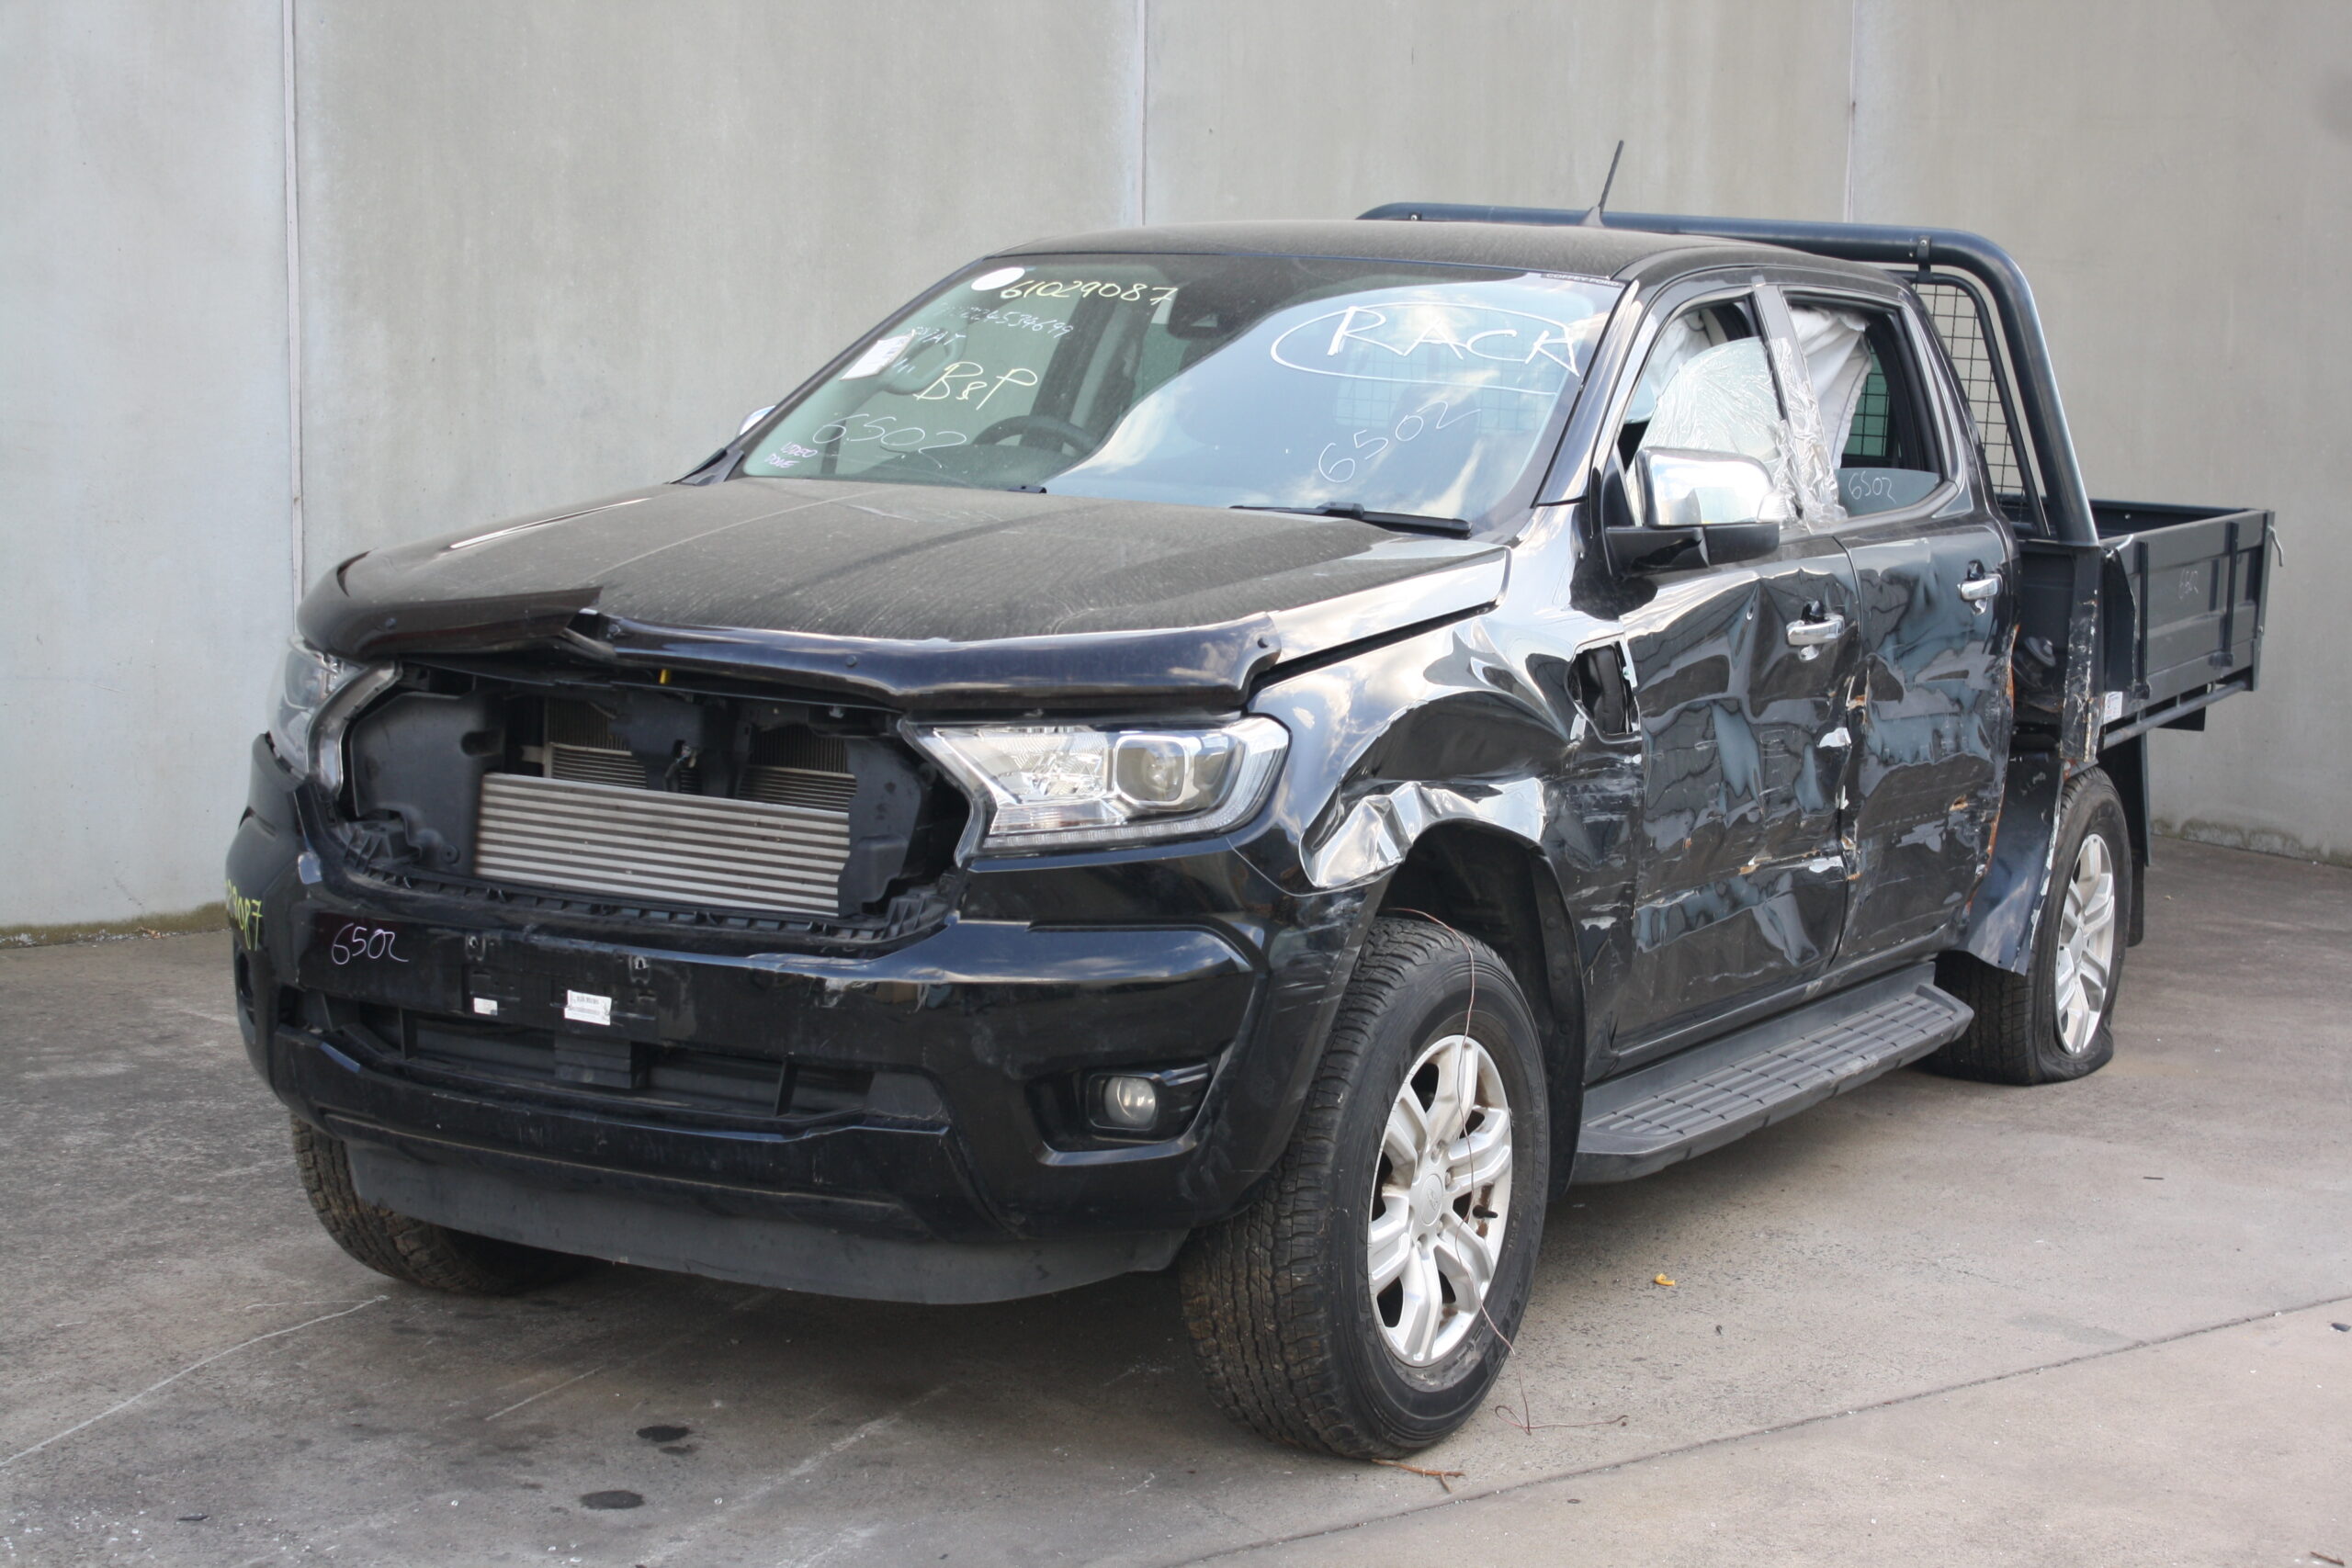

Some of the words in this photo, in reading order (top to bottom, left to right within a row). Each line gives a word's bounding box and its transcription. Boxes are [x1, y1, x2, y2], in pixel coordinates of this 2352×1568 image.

[1000, 279, 1179, 306] 61029087
[1545, 273, 1589, 283] COFFEY
[1589, 277, 1620, 288] FORD
[812, 413, 967, 469] 6502
[1317, 400, 1482, 483] 6502
[1848, 470, 1897, 504] 6502
[332, 922, 409, 965] 6502
